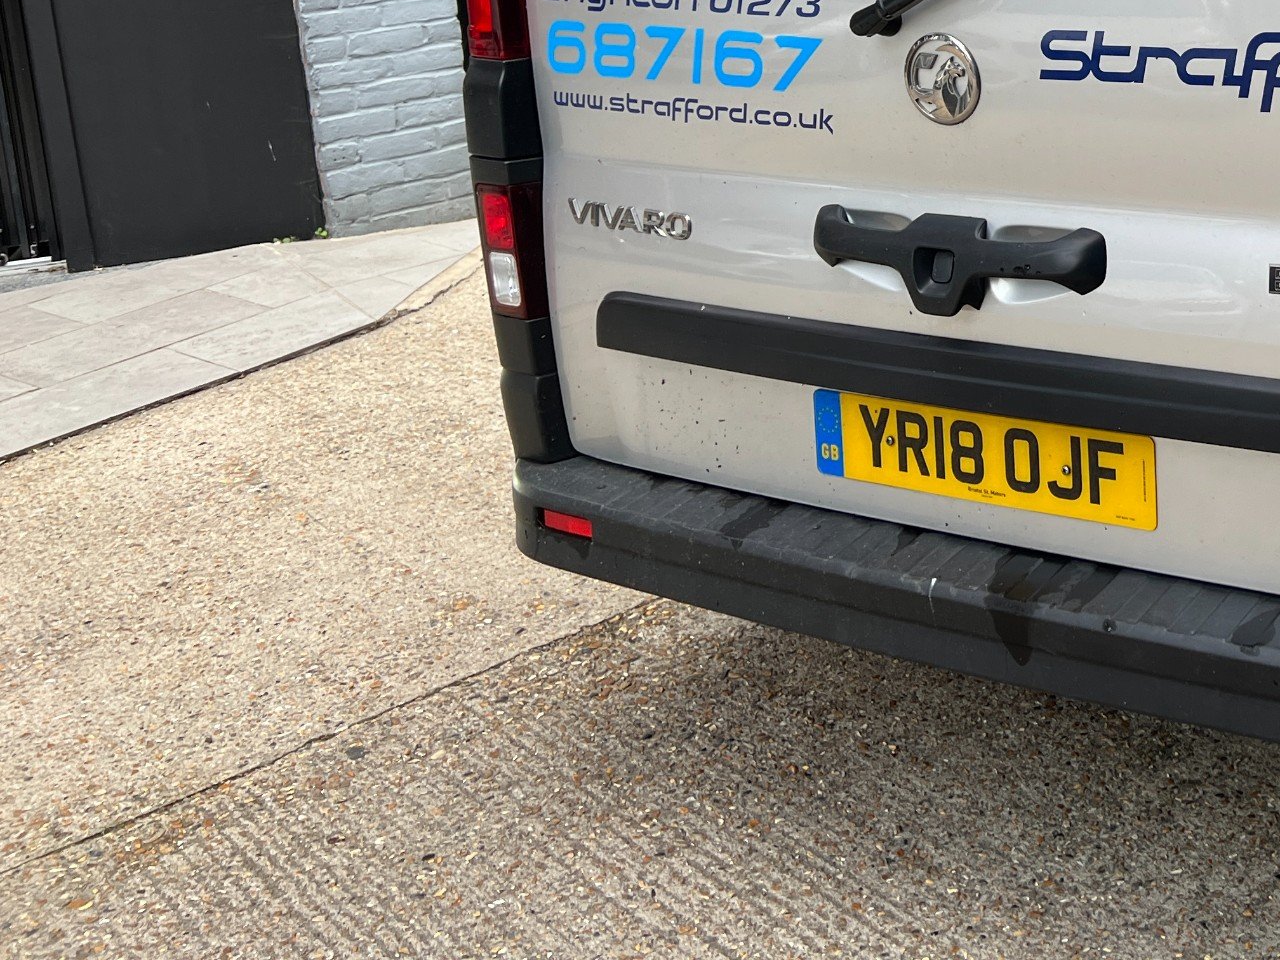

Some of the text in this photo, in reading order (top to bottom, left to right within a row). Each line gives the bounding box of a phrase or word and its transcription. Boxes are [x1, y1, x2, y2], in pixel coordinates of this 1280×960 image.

[547, 19, 824, 93] 687167
[553, 90, 835, 135] www.strafford.co.uk
[567, 197, 693, 241] VIVARO
[821, 442, 840, 461] GB
[858, 403, 985, 486] YR18
[1004, 427, 1124, 505] OJF
